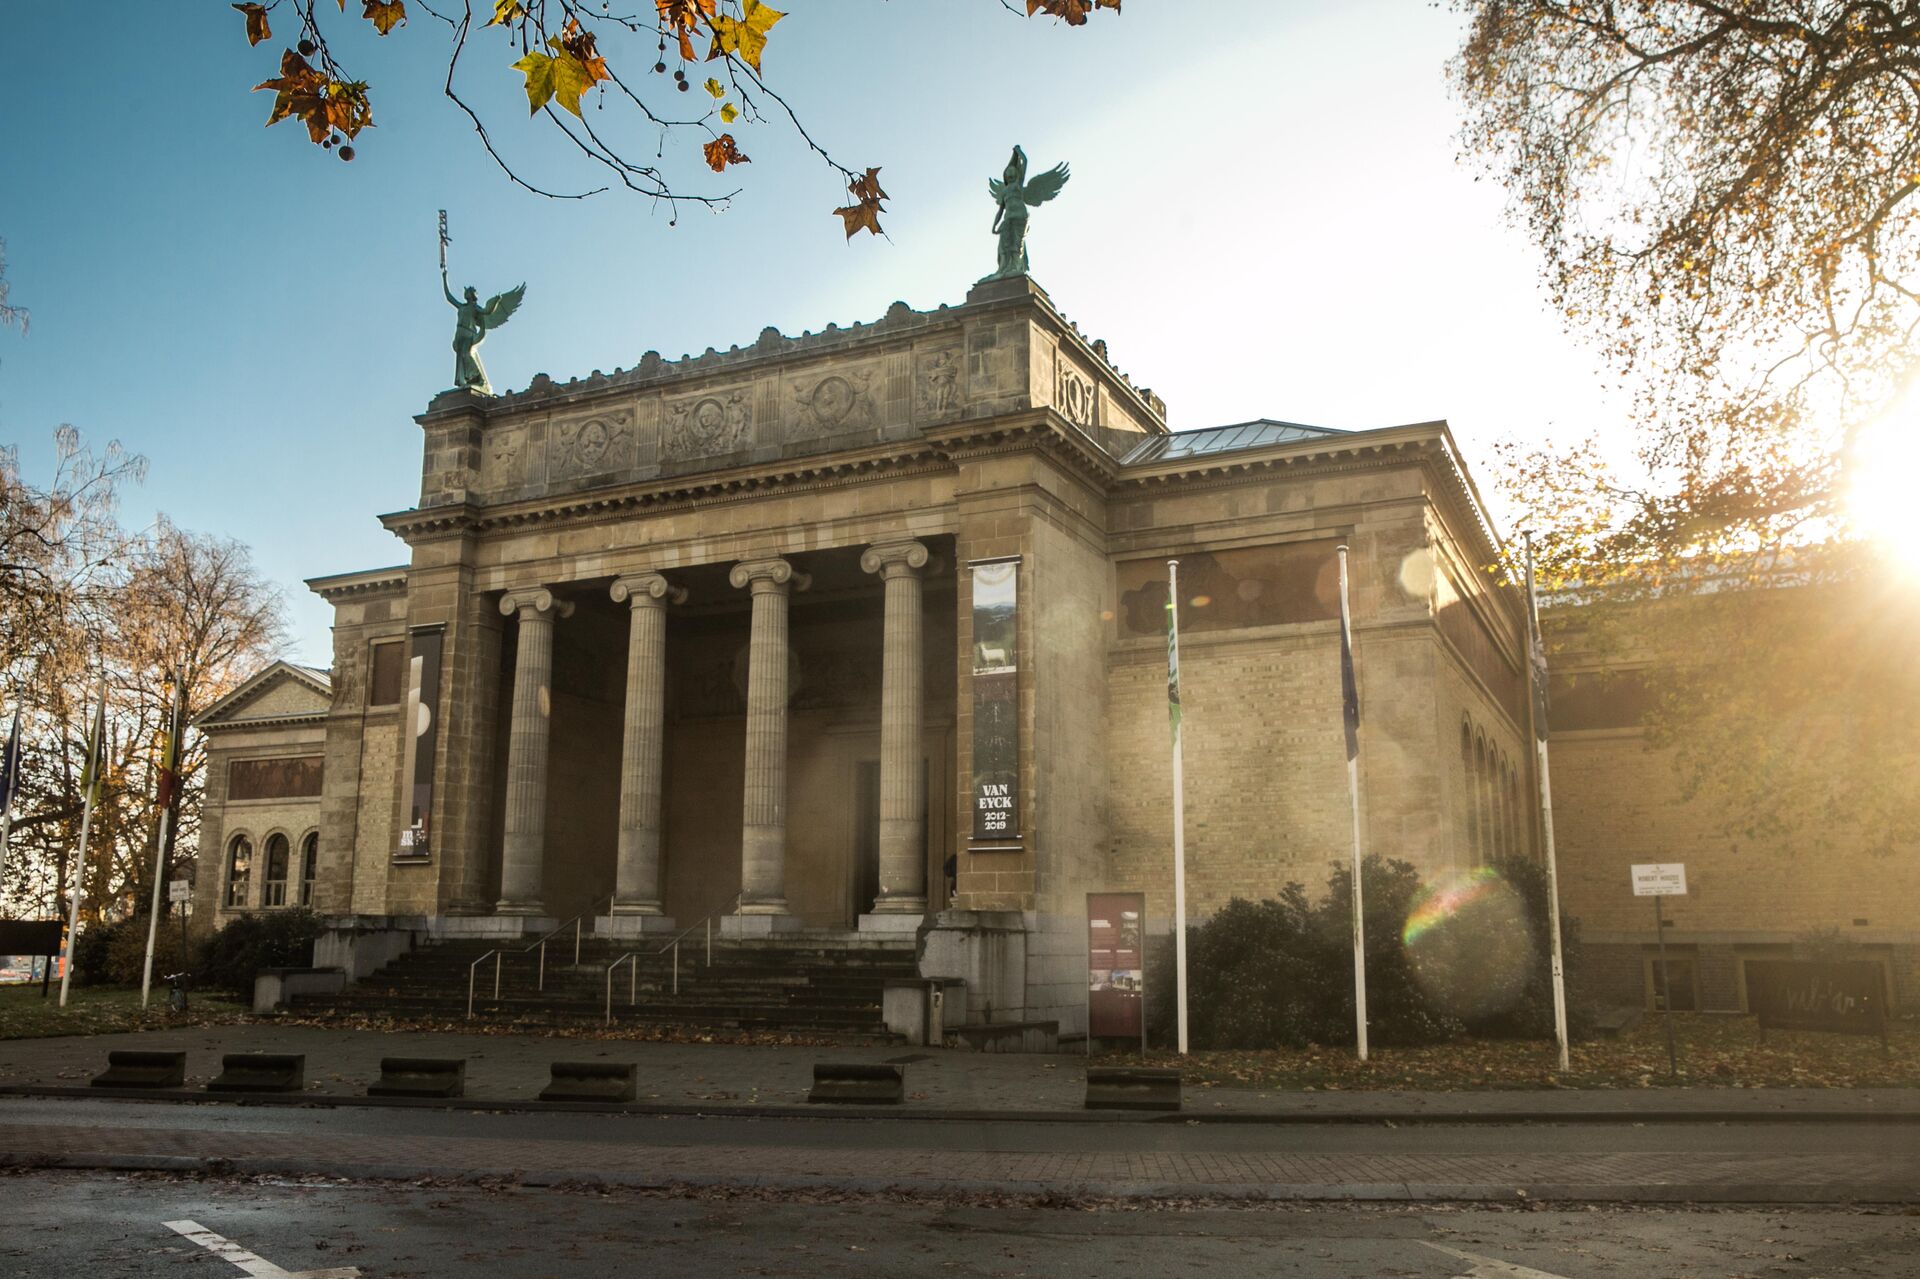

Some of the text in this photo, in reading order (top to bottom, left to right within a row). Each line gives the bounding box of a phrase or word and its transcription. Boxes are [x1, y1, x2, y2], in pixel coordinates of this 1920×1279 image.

[982, 784, 1008, 796] VAN
[979, 796, 1012, 809] EYCK
[984, 811, 1010, 820] 2012-
[984, 821, 1006, 830] 2019
